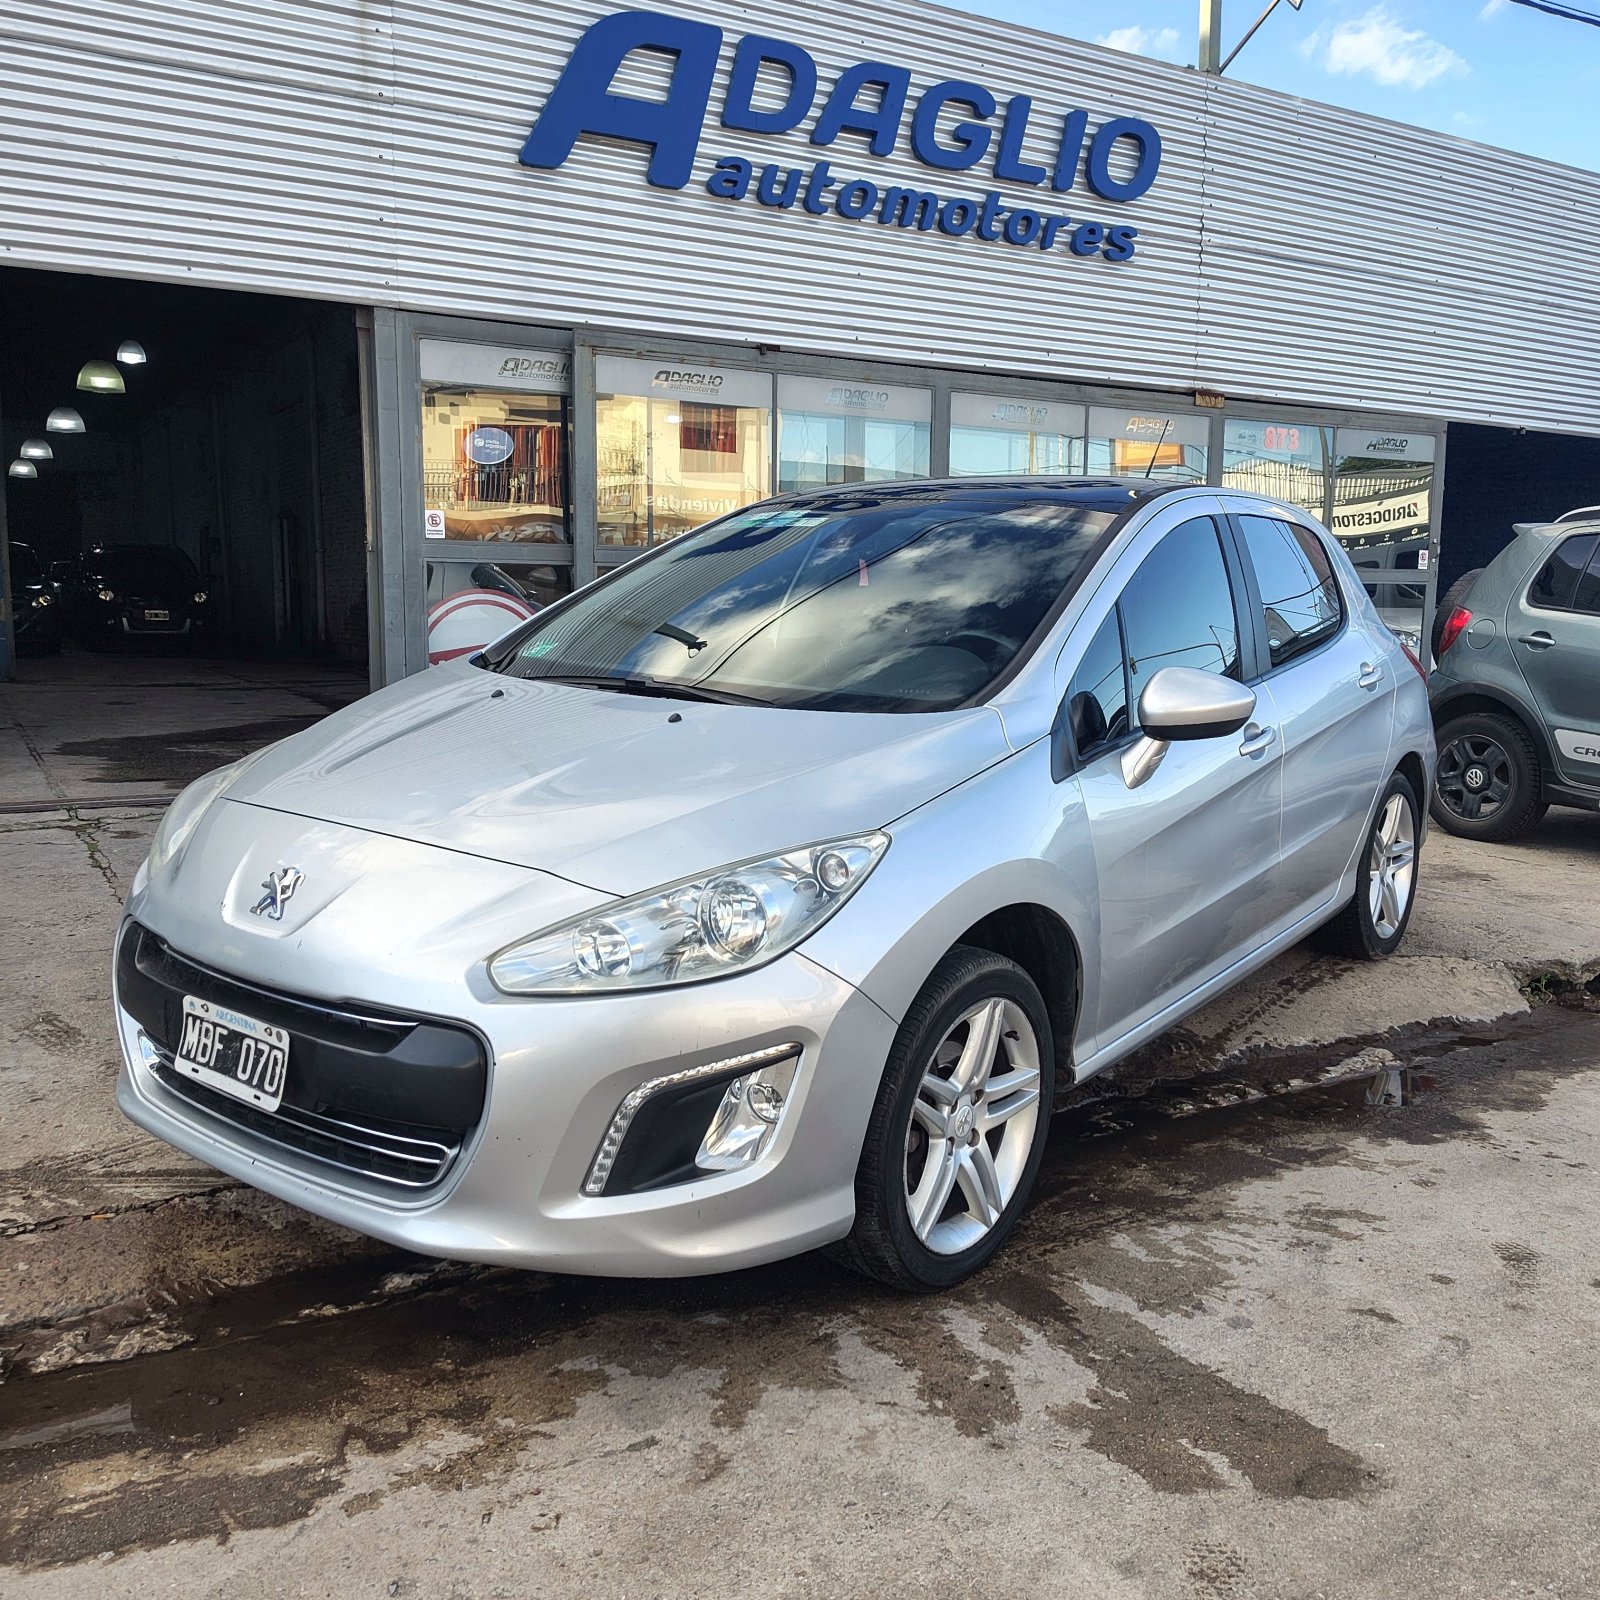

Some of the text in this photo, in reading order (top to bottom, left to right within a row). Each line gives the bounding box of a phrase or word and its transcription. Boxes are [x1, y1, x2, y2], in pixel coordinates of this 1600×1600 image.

[519, 11, 1162, 201] ADAGLIO
[706, 156, 1138, 262] automotores
[518, 371, 570, 382] automotore
[651, 370, 723, 388] ADAGLIO
[669, 383, 720, 394] automotores
[1126, 416, 1175, 432] ADAGLO
[1264, 426, 1300, 451] 873
[1573, 746, 1600, 758] CR
[215, 1009, 258, 1033] ARGENTINA
[182, 1016, 284, 1093] MBF 070
